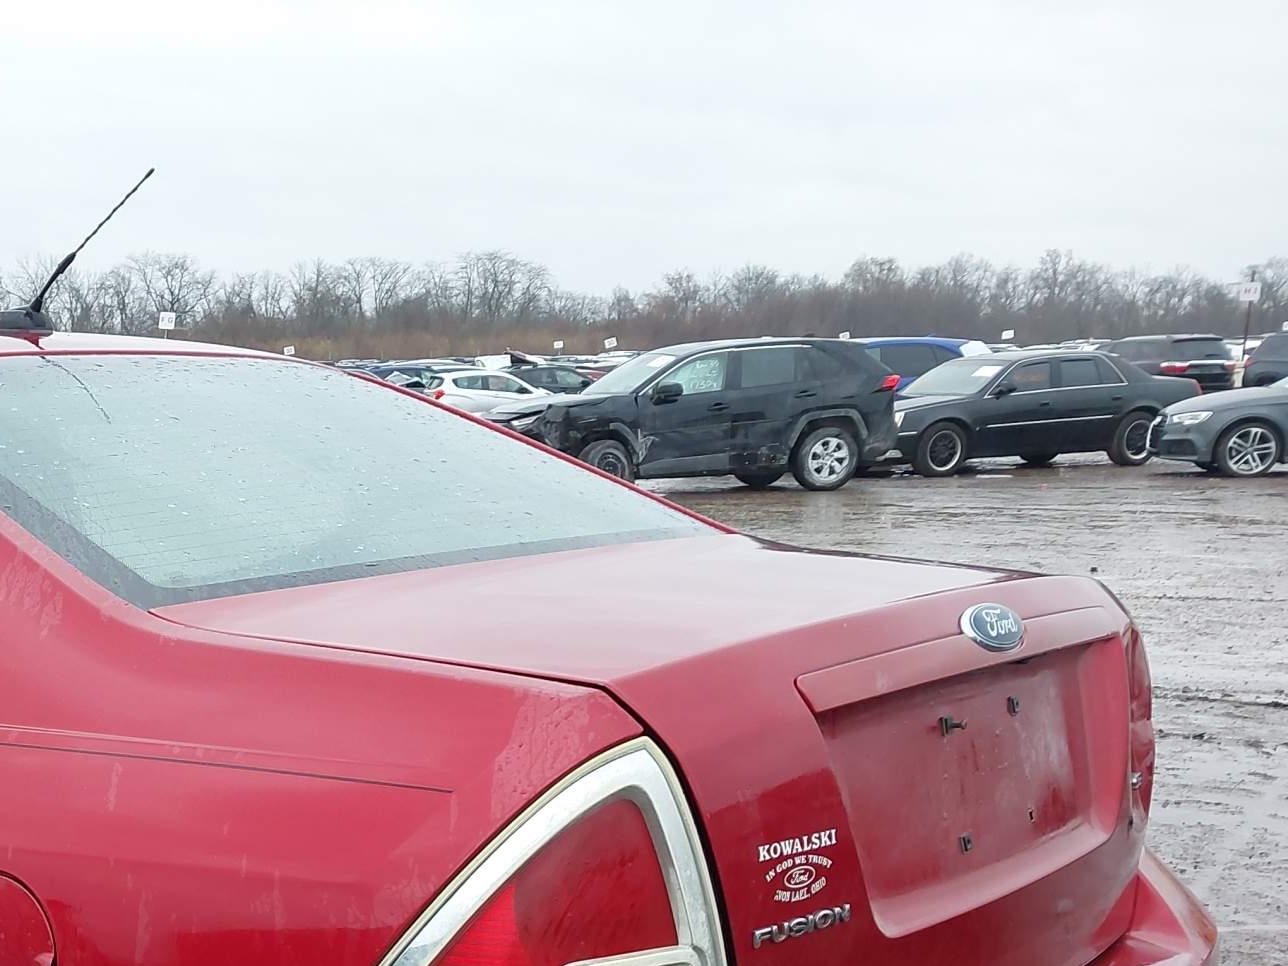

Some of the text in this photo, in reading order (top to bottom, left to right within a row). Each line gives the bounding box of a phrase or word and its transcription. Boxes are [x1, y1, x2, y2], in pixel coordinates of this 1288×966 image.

[981, 608, 1018, 637] Ford
[757, 828, 838, 862] KOWALSKI
[765, 854, 833, 882] IN GOD WE TRUST
[790, 870, 810, 885] Ford
[811, 876, 827, 894] OHIO
[752, 903, 851, 949] FUSION
